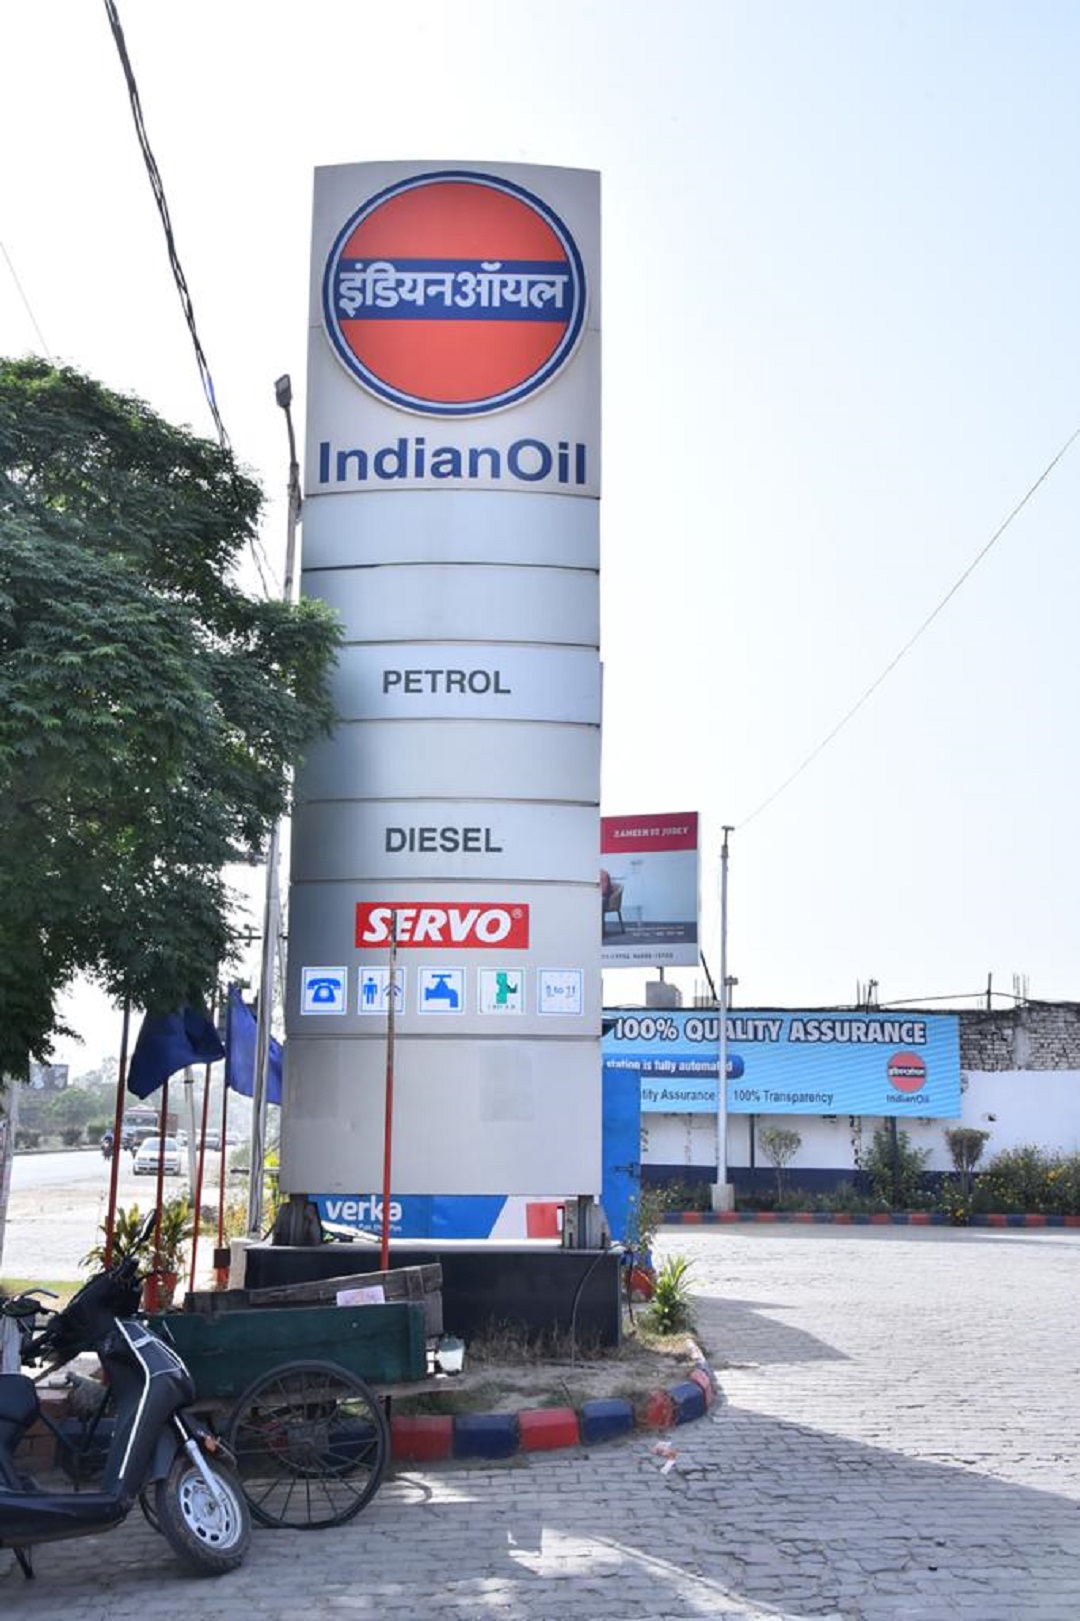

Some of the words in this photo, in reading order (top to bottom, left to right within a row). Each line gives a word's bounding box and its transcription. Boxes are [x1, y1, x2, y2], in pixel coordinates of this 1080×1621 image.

[338, 261, 569, 317] इंडियनऑयल
[319, 437, 586, 484] IndianOil
[383, 670, 511, 694] PETROL
[385, 827, 503, 853] DIESEL
[362, 907, 512, 942] SERVO
[614, 1017, 679, 1041] 100%
[685, 1018, 782, 1042] QUALITY
[788, 1018, 927, 1044] ASSURANCE
[643, 1059, 652, 1071] is
[654, 1059, 677, 1073] fully
[679, 1060, 733, 1072] automatd
[660, 1088, 715, 1102] Assurance
[734, 1089, 760, 1102] 100%
[763, 1089, 834, 1106] Transparency
[325, 1195, 403, 1221] verka
